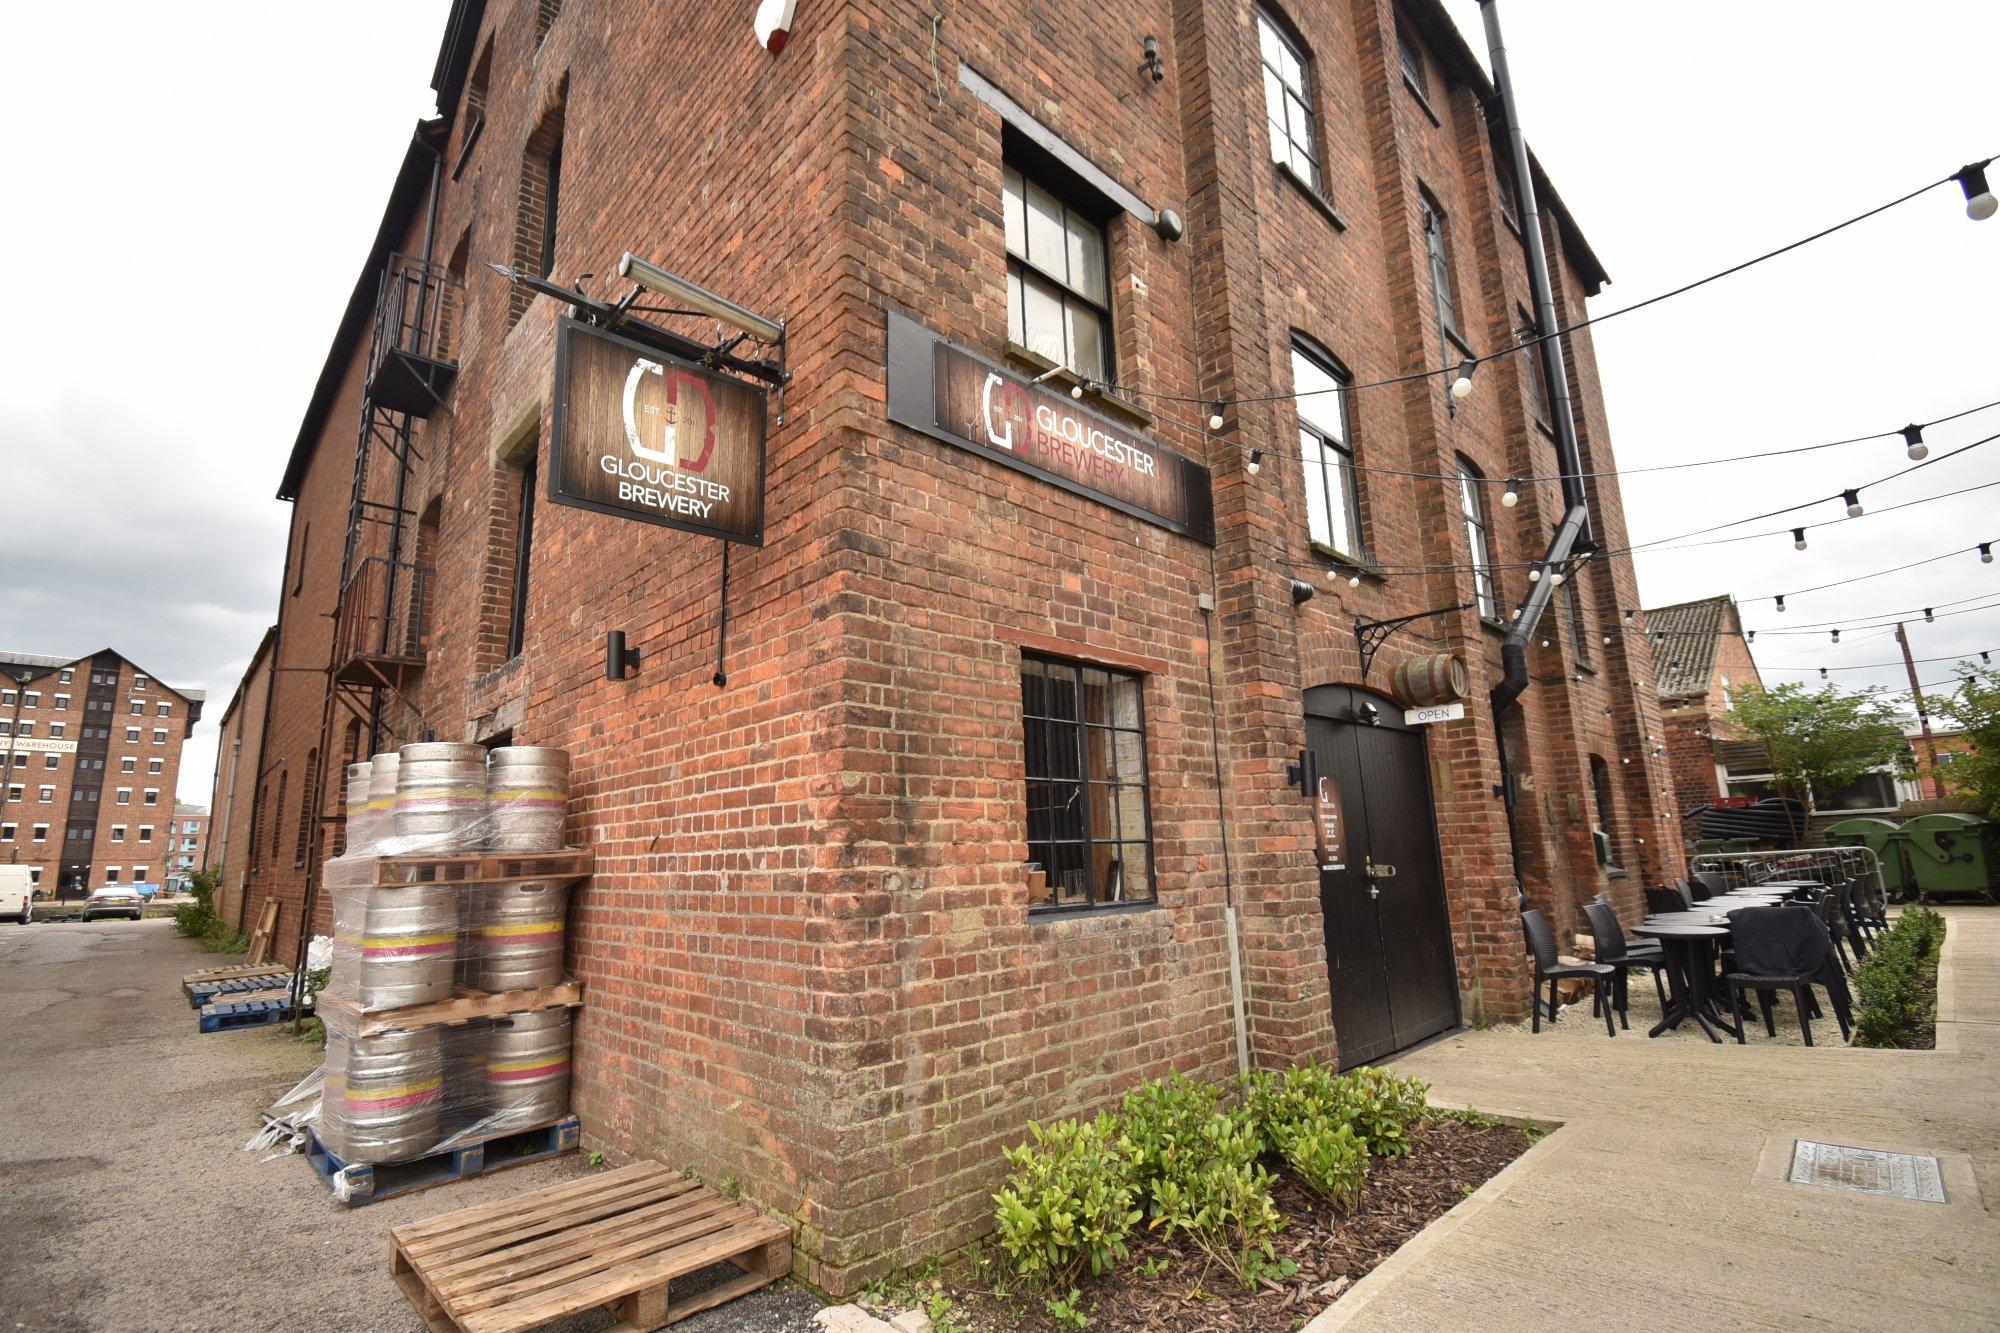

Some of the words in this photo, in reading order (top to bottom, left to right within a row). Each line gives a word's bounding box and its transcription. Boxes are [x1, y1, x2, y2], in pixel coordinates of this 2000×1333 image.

[644, 404, 660, 416] EST
[1036, 405, 1155, 477] GLOUCESTER
[1037, 430, 1125, 483] BREWERY
[600, 454, 730, 503] GLOUCESTER
[618, 481, 713, 519] BREWERY
[1417, 710, 1449, 720] OPEN
[16, 741, 75, 750] WAREHOUSE
